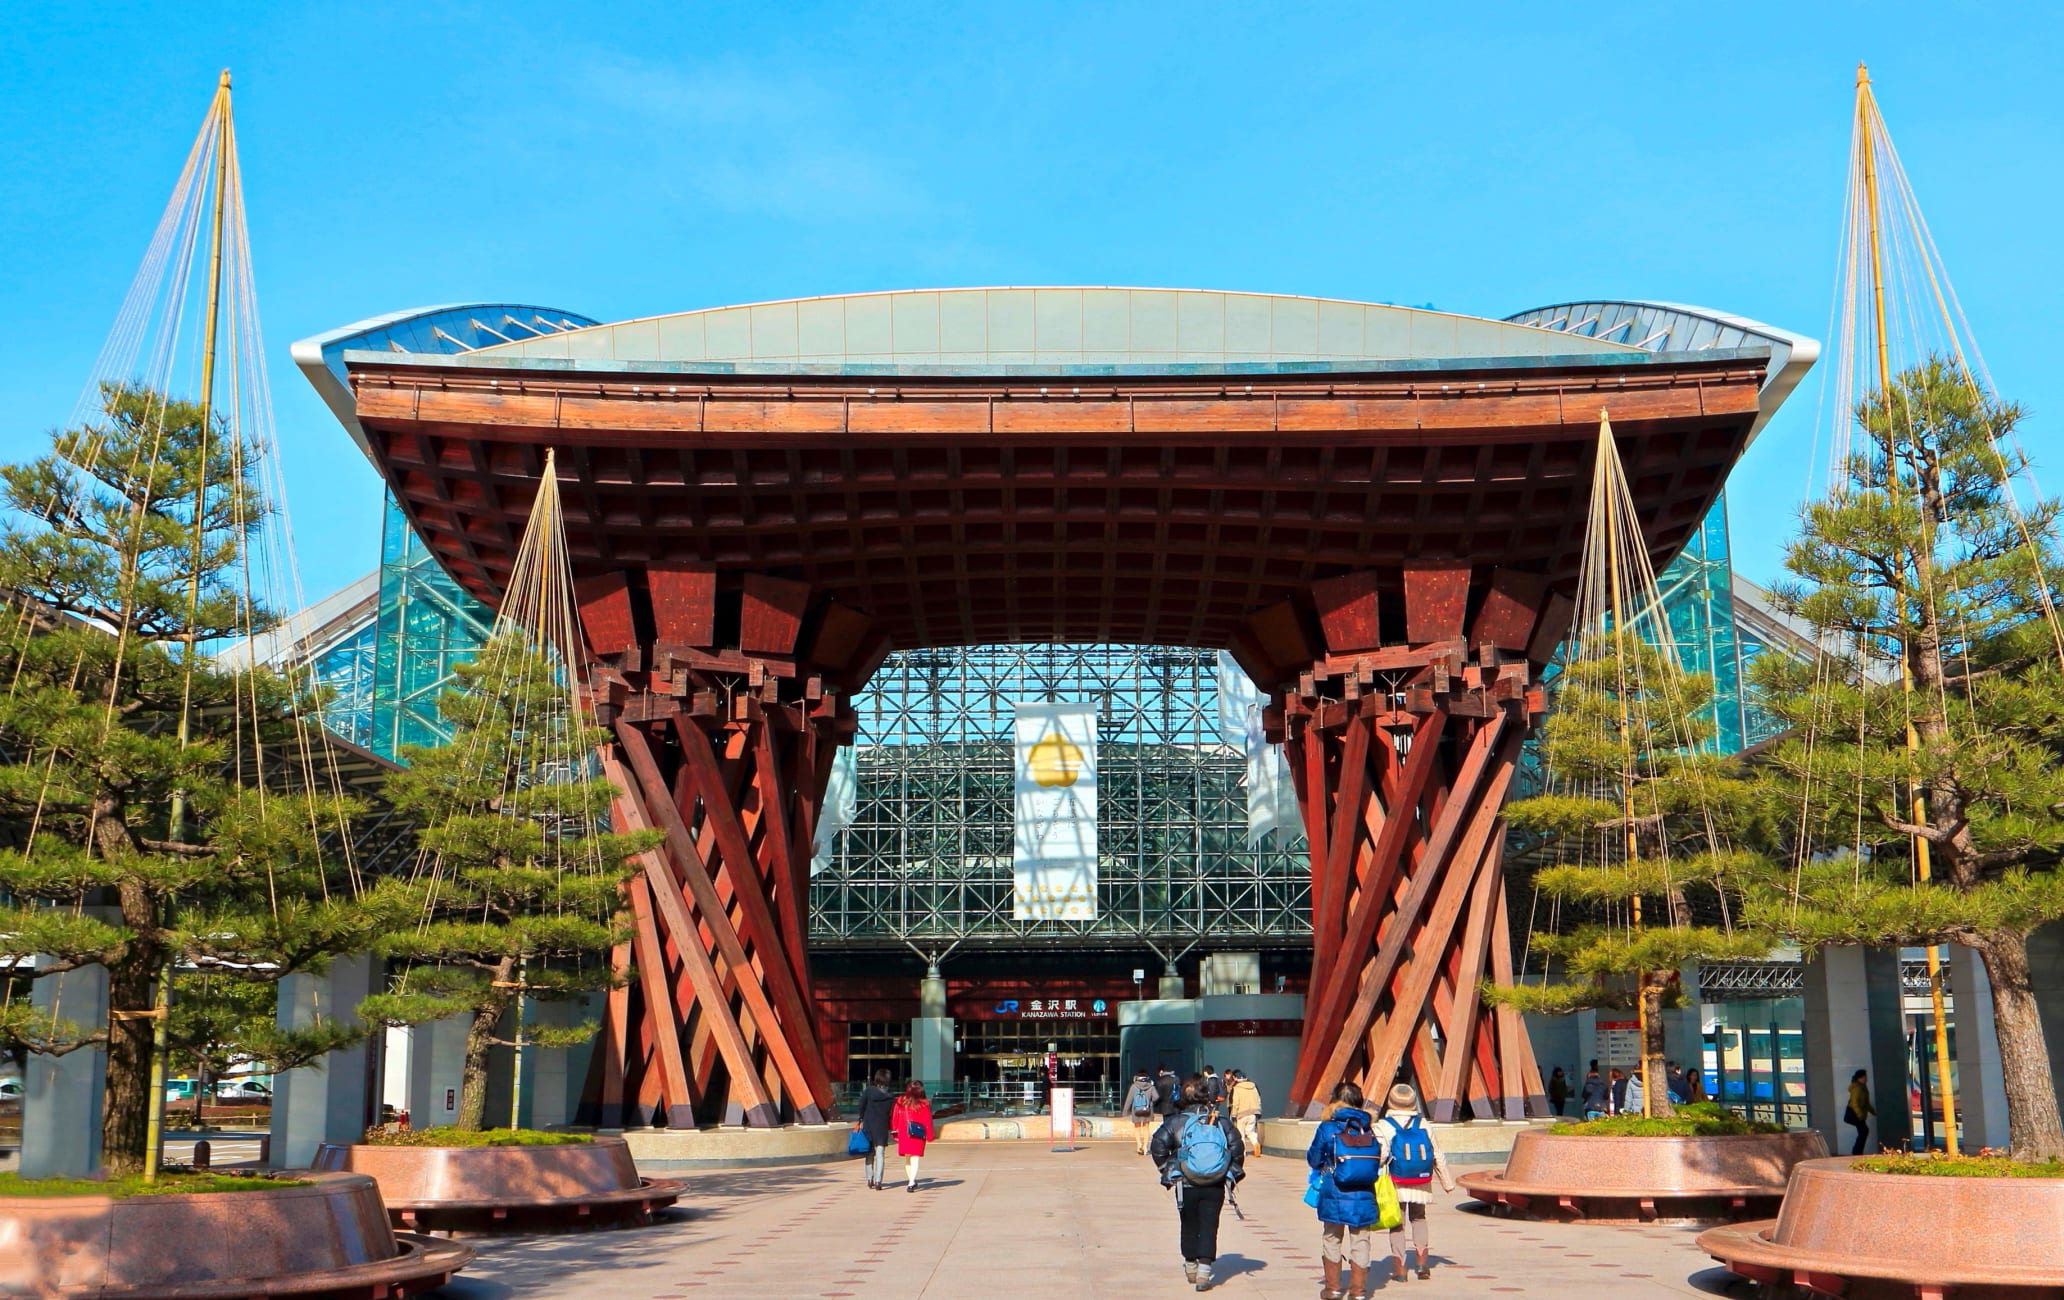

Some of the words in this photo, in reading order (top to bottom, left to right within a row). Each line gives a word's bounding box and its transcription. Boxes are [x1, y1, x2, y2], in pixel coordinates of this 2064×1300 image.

[994, 1000, 1019, 1014] JR
[1031, 1000, 1077, 1010] 金沢駅
